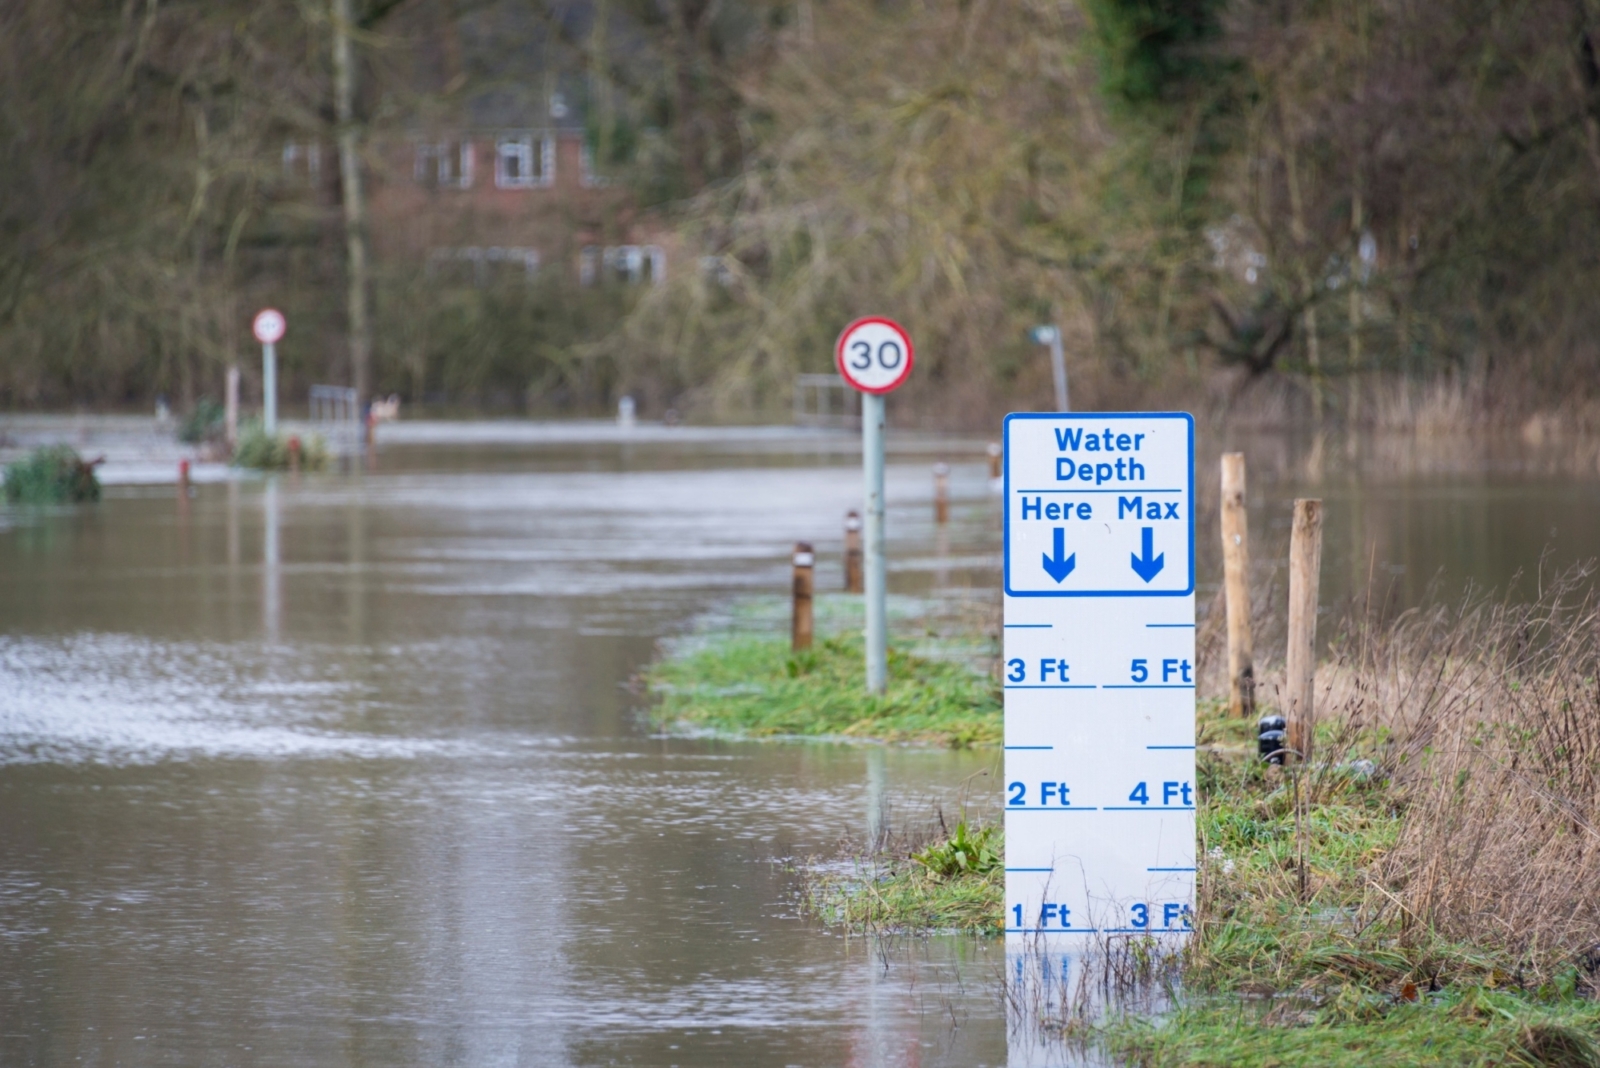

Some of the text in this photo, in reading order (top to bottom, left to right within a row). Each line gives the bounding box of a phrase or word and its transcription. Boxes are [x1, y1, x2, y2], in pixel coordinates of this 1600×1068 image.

[851, 341, 901, 370] 30
[1054, 428, 1145, 451] Water
[1056, 457, 1145, 485] Depth
[1022, 497, 1092, 520] Here
[1118, 496, 1180, 520] Max
[1007, 658, 1070, 683] 3 Ft
[1131, 659, 1192, 683] 5 Ft
[1008, 782, 1070, 805] 2 Ft
[1129, 782, 1192, 805] 4 Ft
[1012, 904, 1071, 927] 1 Ft
[1131, 904, 1149, 927] 3
